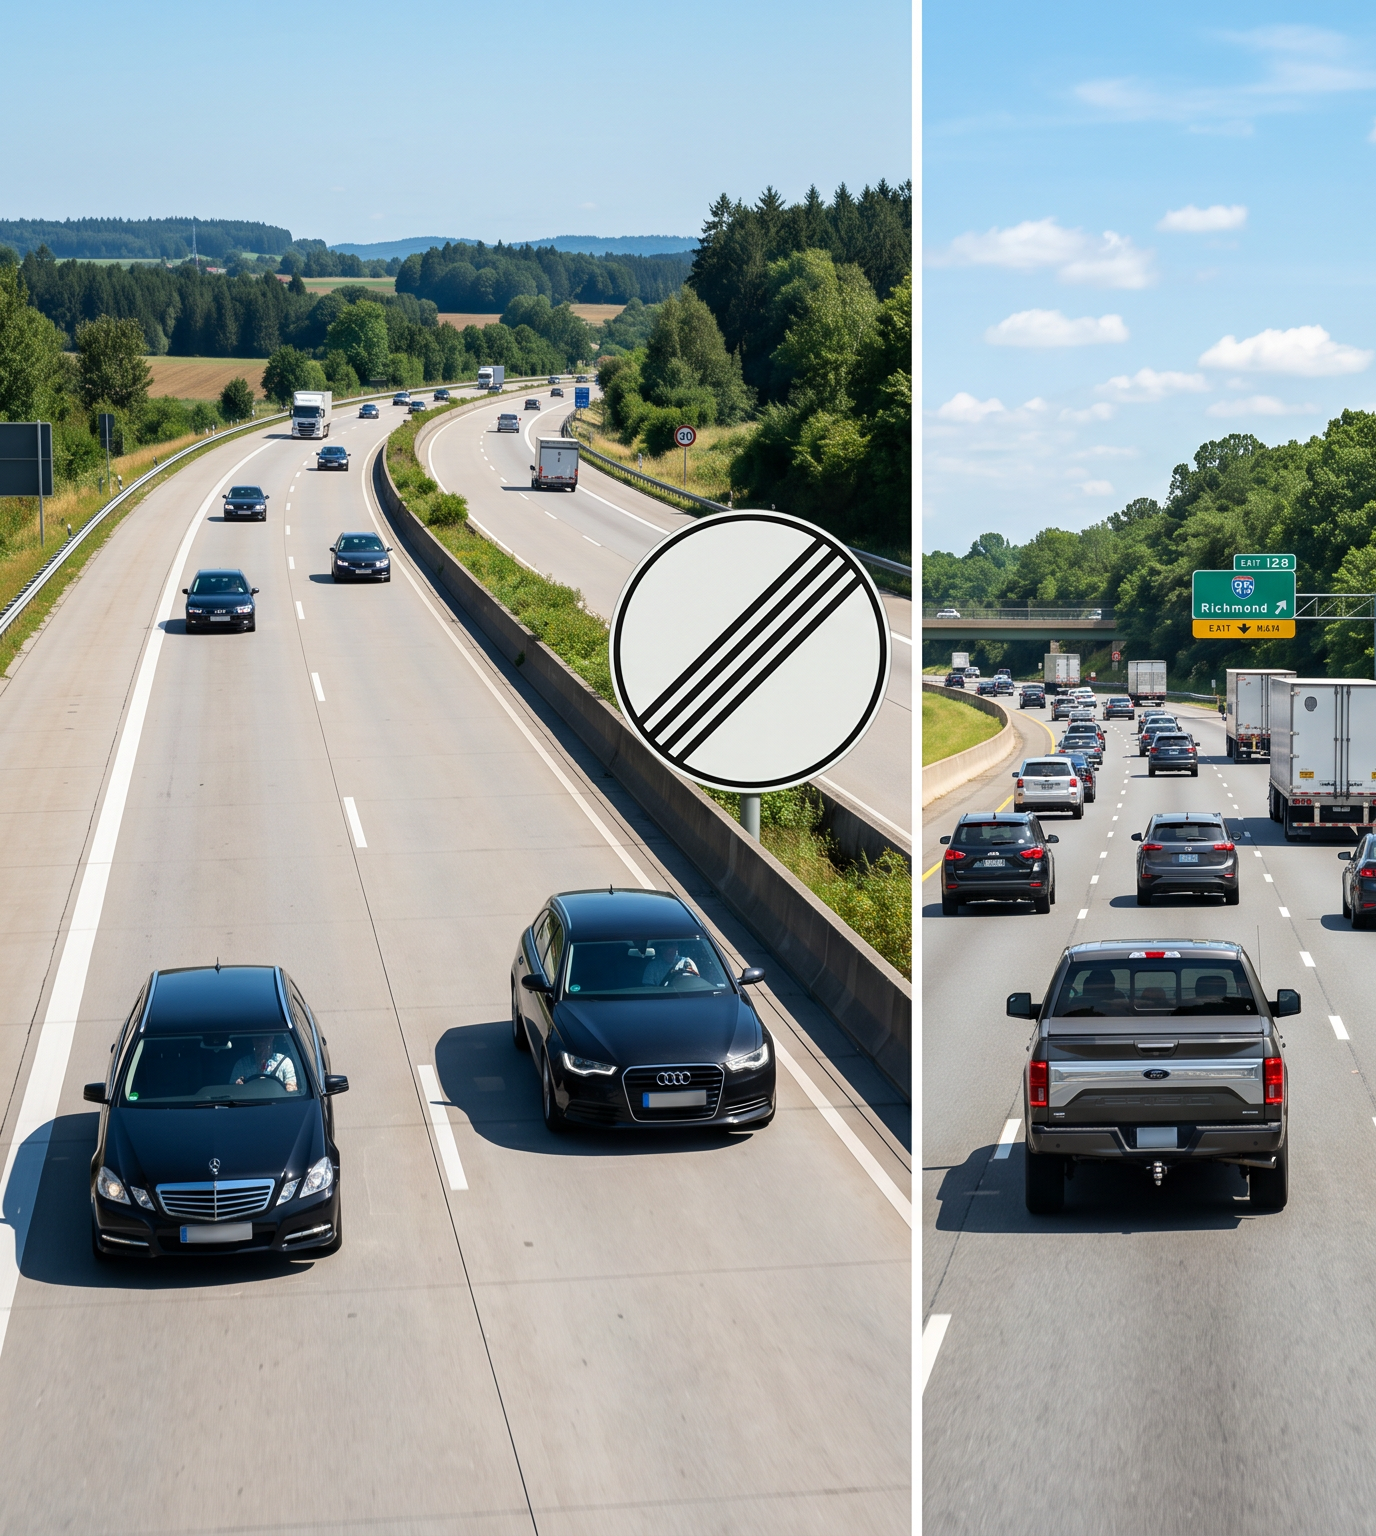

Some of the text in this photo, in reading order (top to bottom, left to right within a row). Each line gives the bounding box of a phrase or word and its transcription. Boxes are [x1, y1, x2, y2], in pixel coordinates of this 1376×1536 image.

[679, 431, 693, 442] 30
[1266, 557, 1289, 568] 128
[1201, 603, 1268, 613] Richmond
